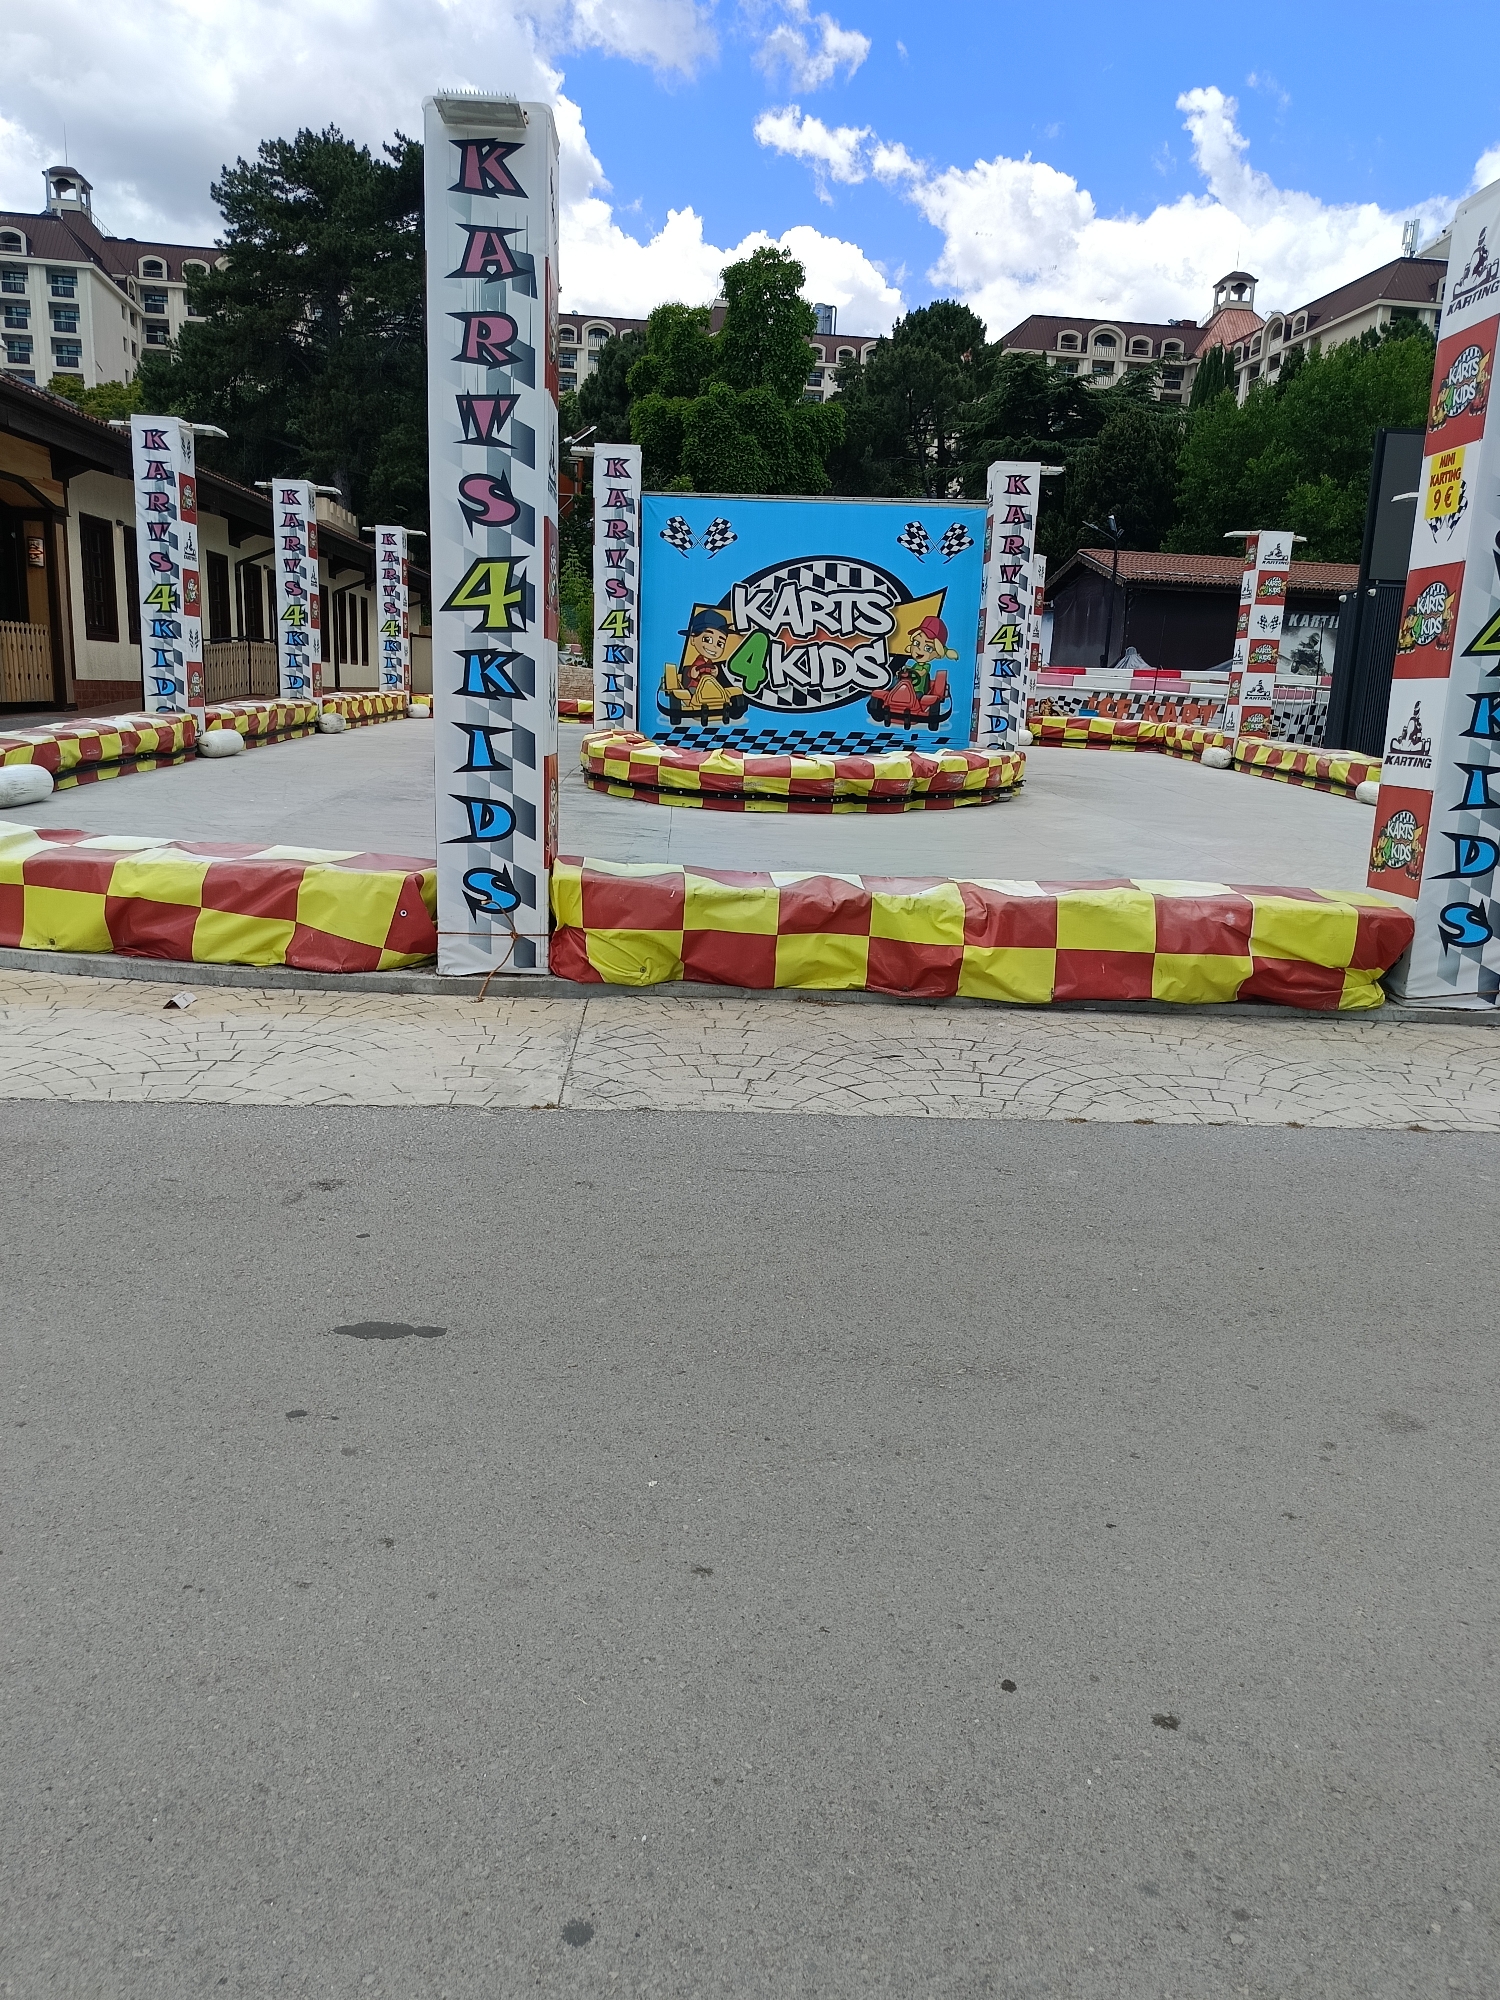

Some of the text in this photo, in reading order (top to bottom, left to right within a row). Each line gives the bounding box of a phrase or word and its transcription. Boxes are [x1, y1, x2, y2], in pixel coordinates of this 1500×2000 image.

[1446, 280, 1500, 317] KARTING
[1449, 357, 1479, 386] KARTS
[1453, 378, 1475, 407] KIDS
[1439, 452, 1456, 469] MINI
[1430, 467, 1462, 488] KARTING
[1433, 486, 1454, 511] 9 €
[732, 581, 896, 637] KARTS
[1416, 594, 1446, 615] KARTS
[1421, 614, 1442, 635] KIDS
[728, 631, 891, 693] 4 KIDS
[1143, 701, 1218, 726] KART
[1384, 755, 1432, 769] KARTING
[1386, 819, 1414, 840] KARTS
[1391, 842, 1412, 861] KIDS
